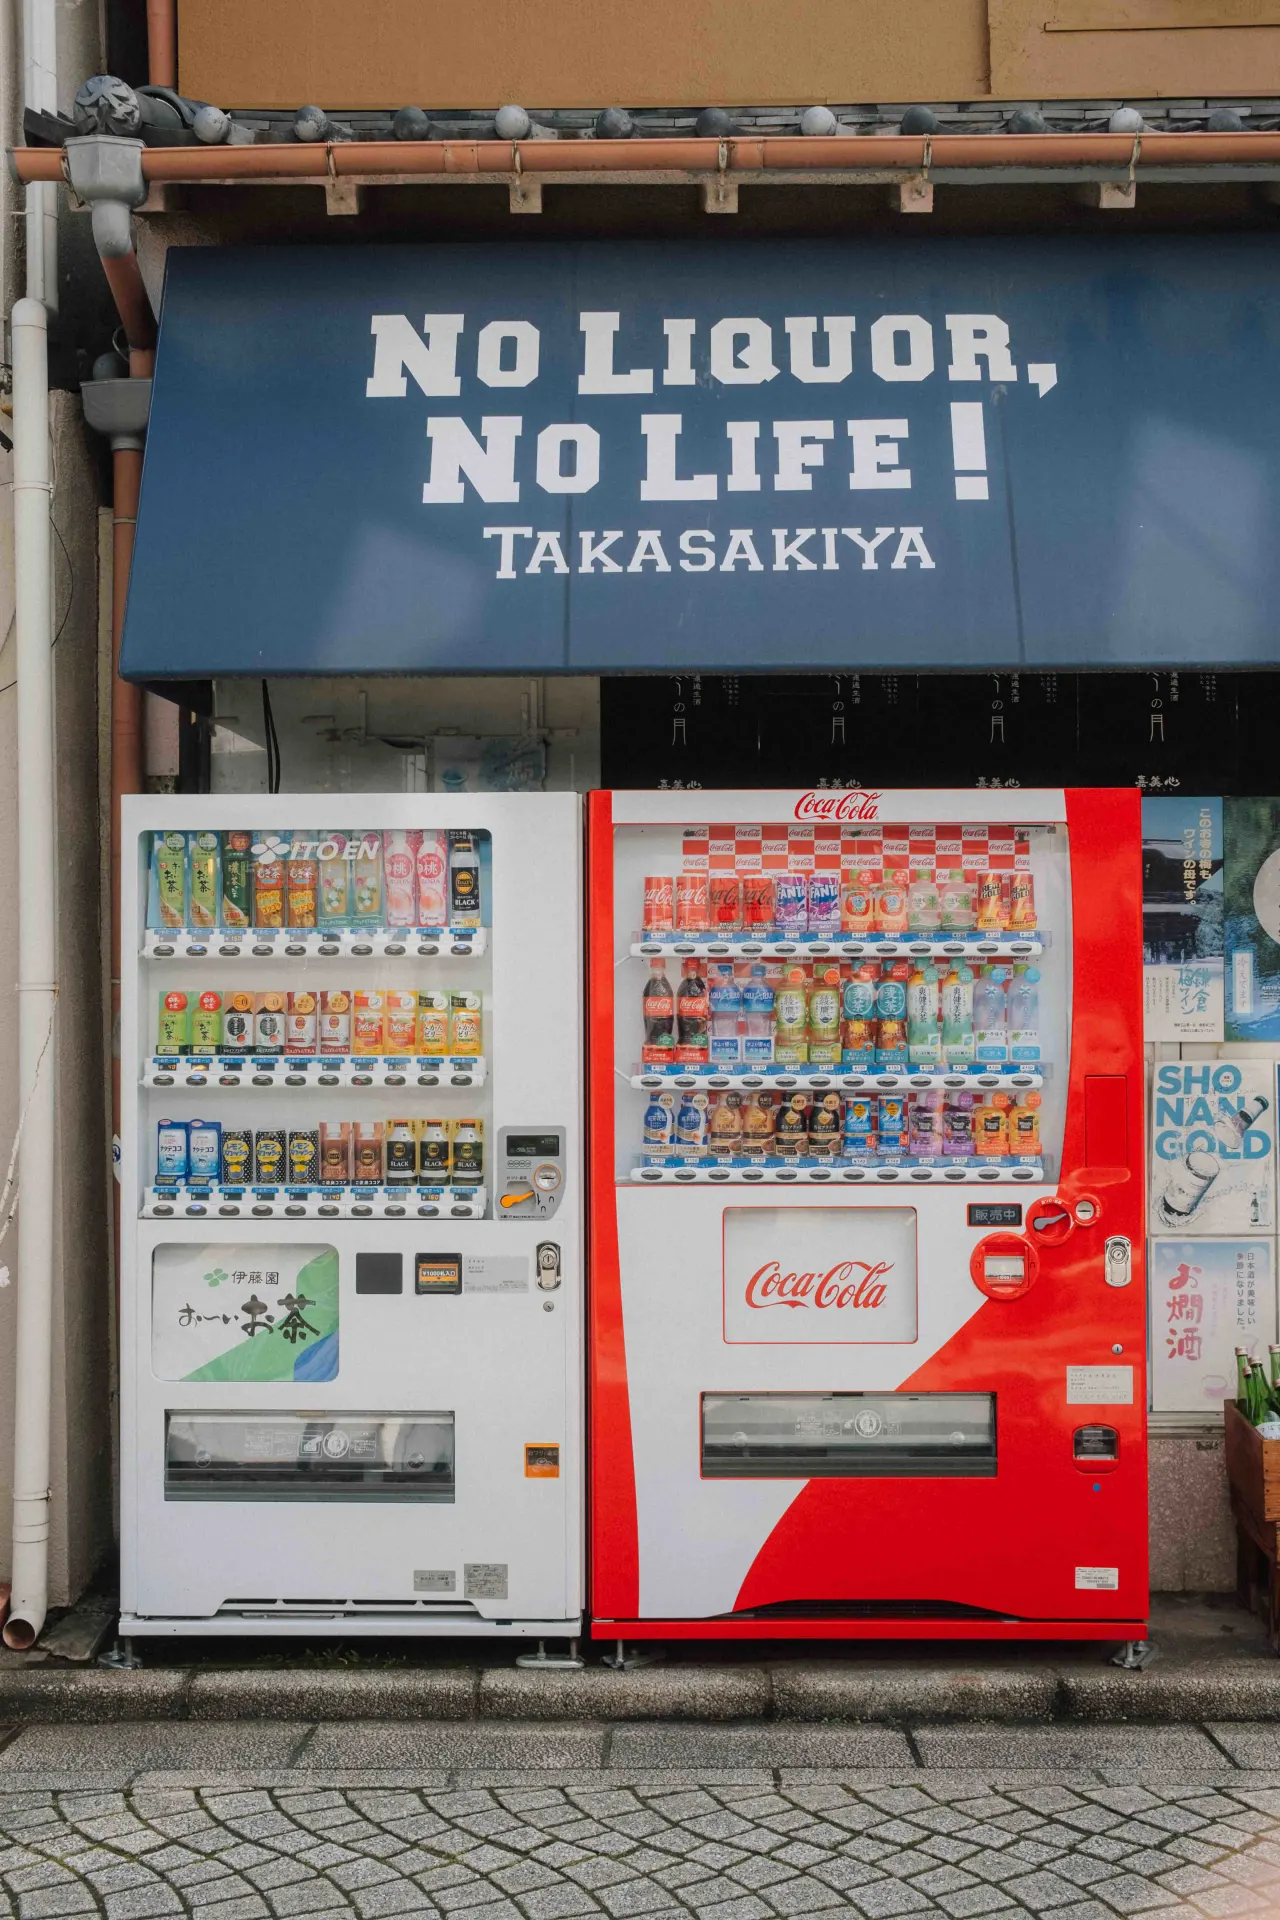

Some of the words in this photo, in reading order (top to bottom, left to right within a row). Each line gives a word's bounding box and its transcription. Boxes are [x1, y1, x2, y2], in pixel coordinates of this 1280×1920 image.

[367, 312, 539, 397] NO
[579, 312, 1057, 397] LIQUOR,
[423, 416, 599, 503] NO
[484, 527, 935, 578] TAKASAKIYA
[794, 792, 880, 820] Coca-Cola
[291, 841, 338, 861] ITO
[341, 841, 379, 860] EN
[393, 862, 408, 876] 桃
[424, 862, 439, 876] 桃
[852, 985, 866, 1011] 麦茶
[885, 985, 898, 1011] 麦茶
[1157, 1065, 1242, 1094] SHO
[1156, 1096, 1245, 1127] NAN
[1155, 1130, 1271, 1160] GOLD
[975, 1209, 1016, 1221] 販売中
[232, 1271, 279, 1285] 伊藤園
[746, 1262, 892, 1308] Coca-Cola
[1236, 1252, 1246, 1330] 季節になりました。
[1247, 1252, 1256, 1325] 日本酒が美味しい
[1166, 1263, 1204, 1361] お燗酒
